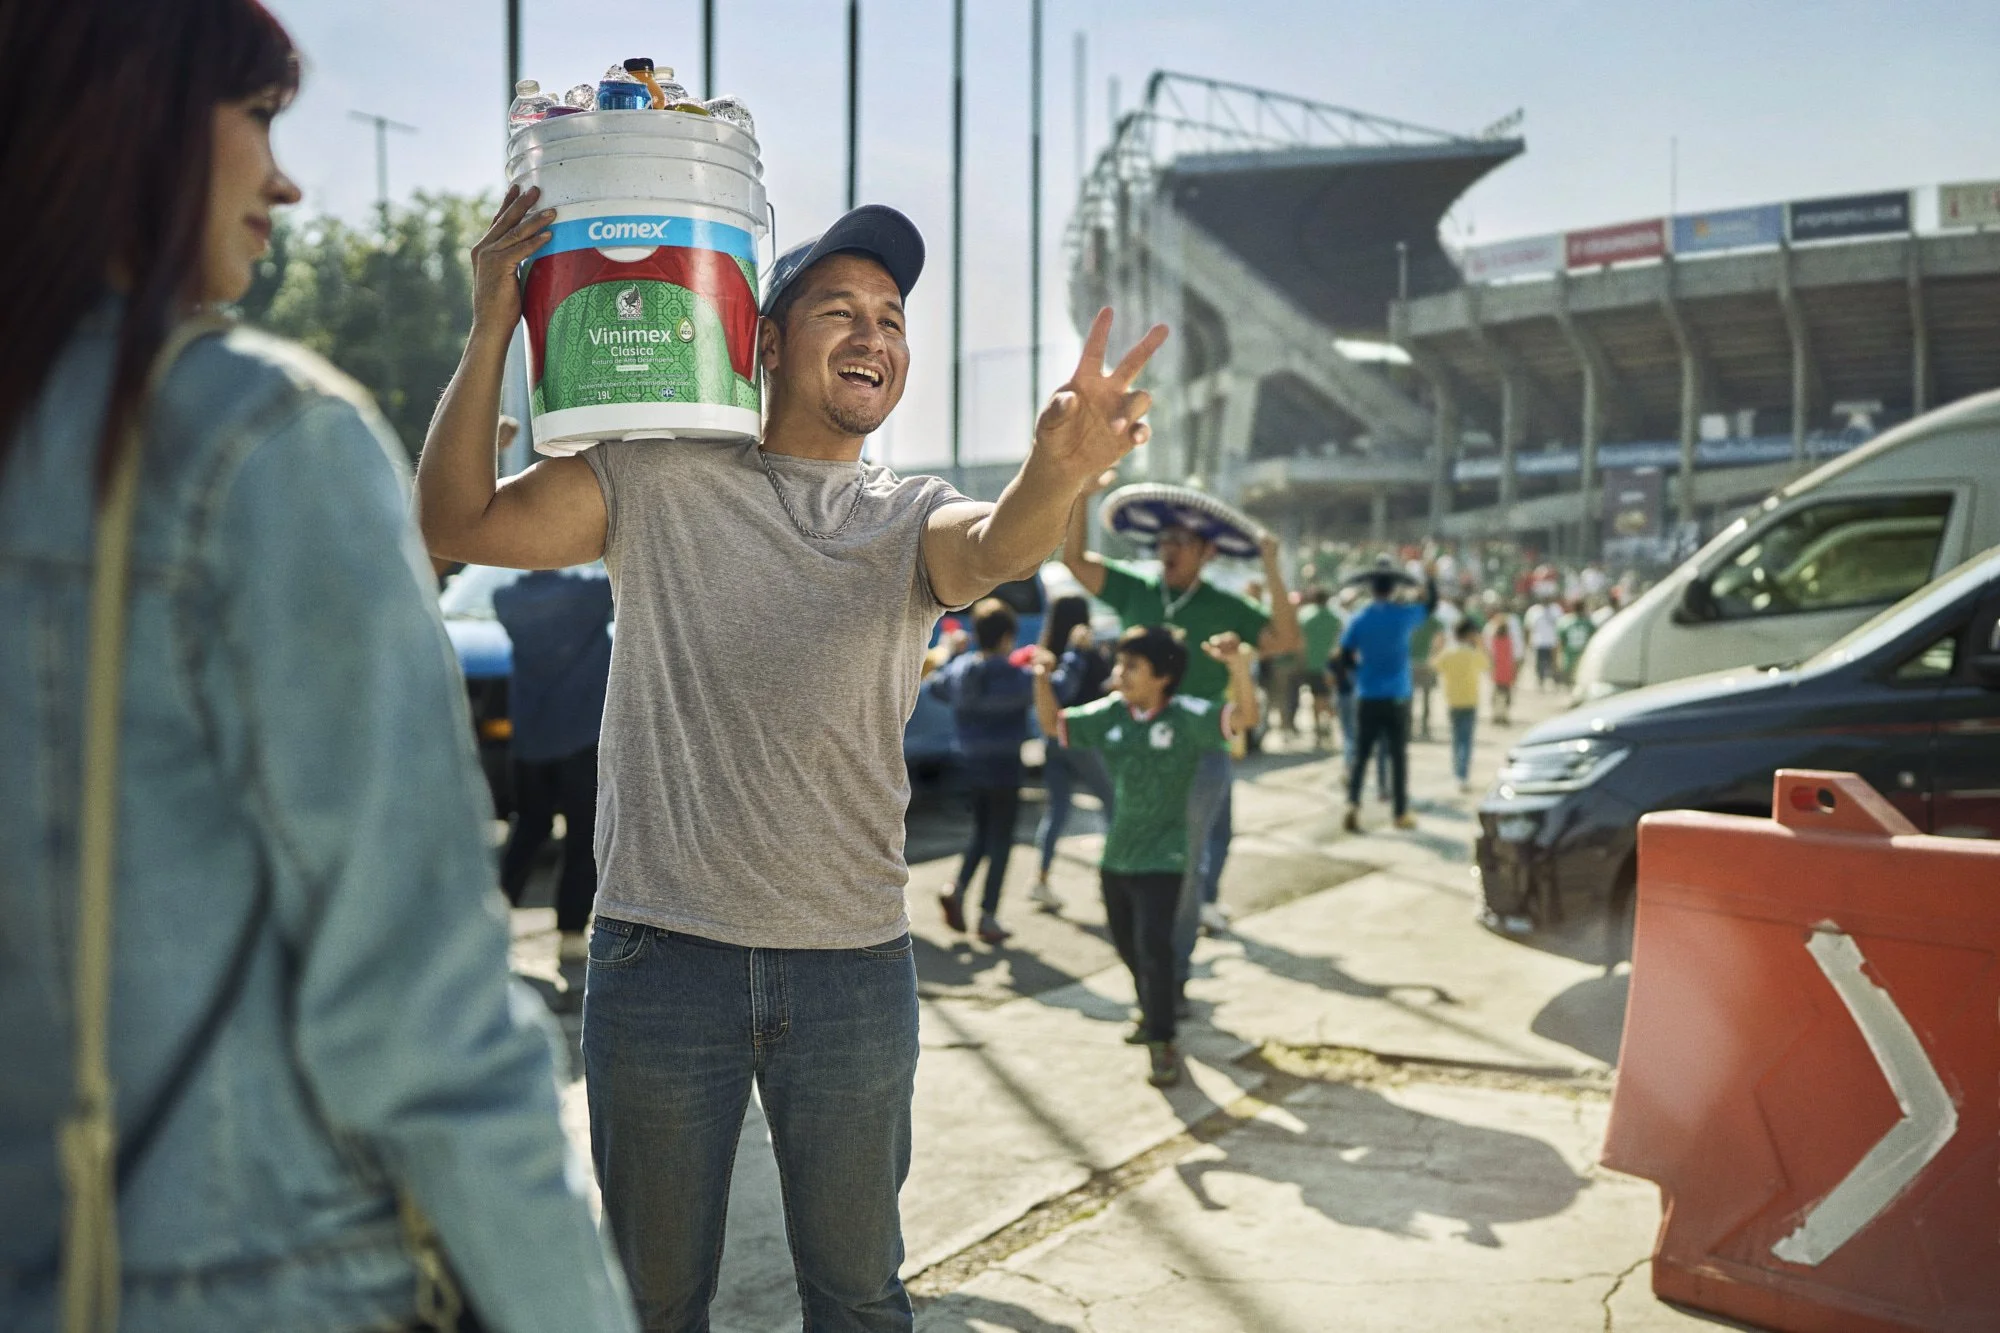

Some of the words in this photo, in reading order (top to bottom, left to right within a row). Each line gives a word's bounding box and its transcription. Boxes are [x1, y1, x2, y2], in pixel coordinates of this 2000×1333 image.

[588, 219, 672, 240] Comex
[588, 326, 672, 345] Vinimex
[611, 345, 654, 357] Clásica
